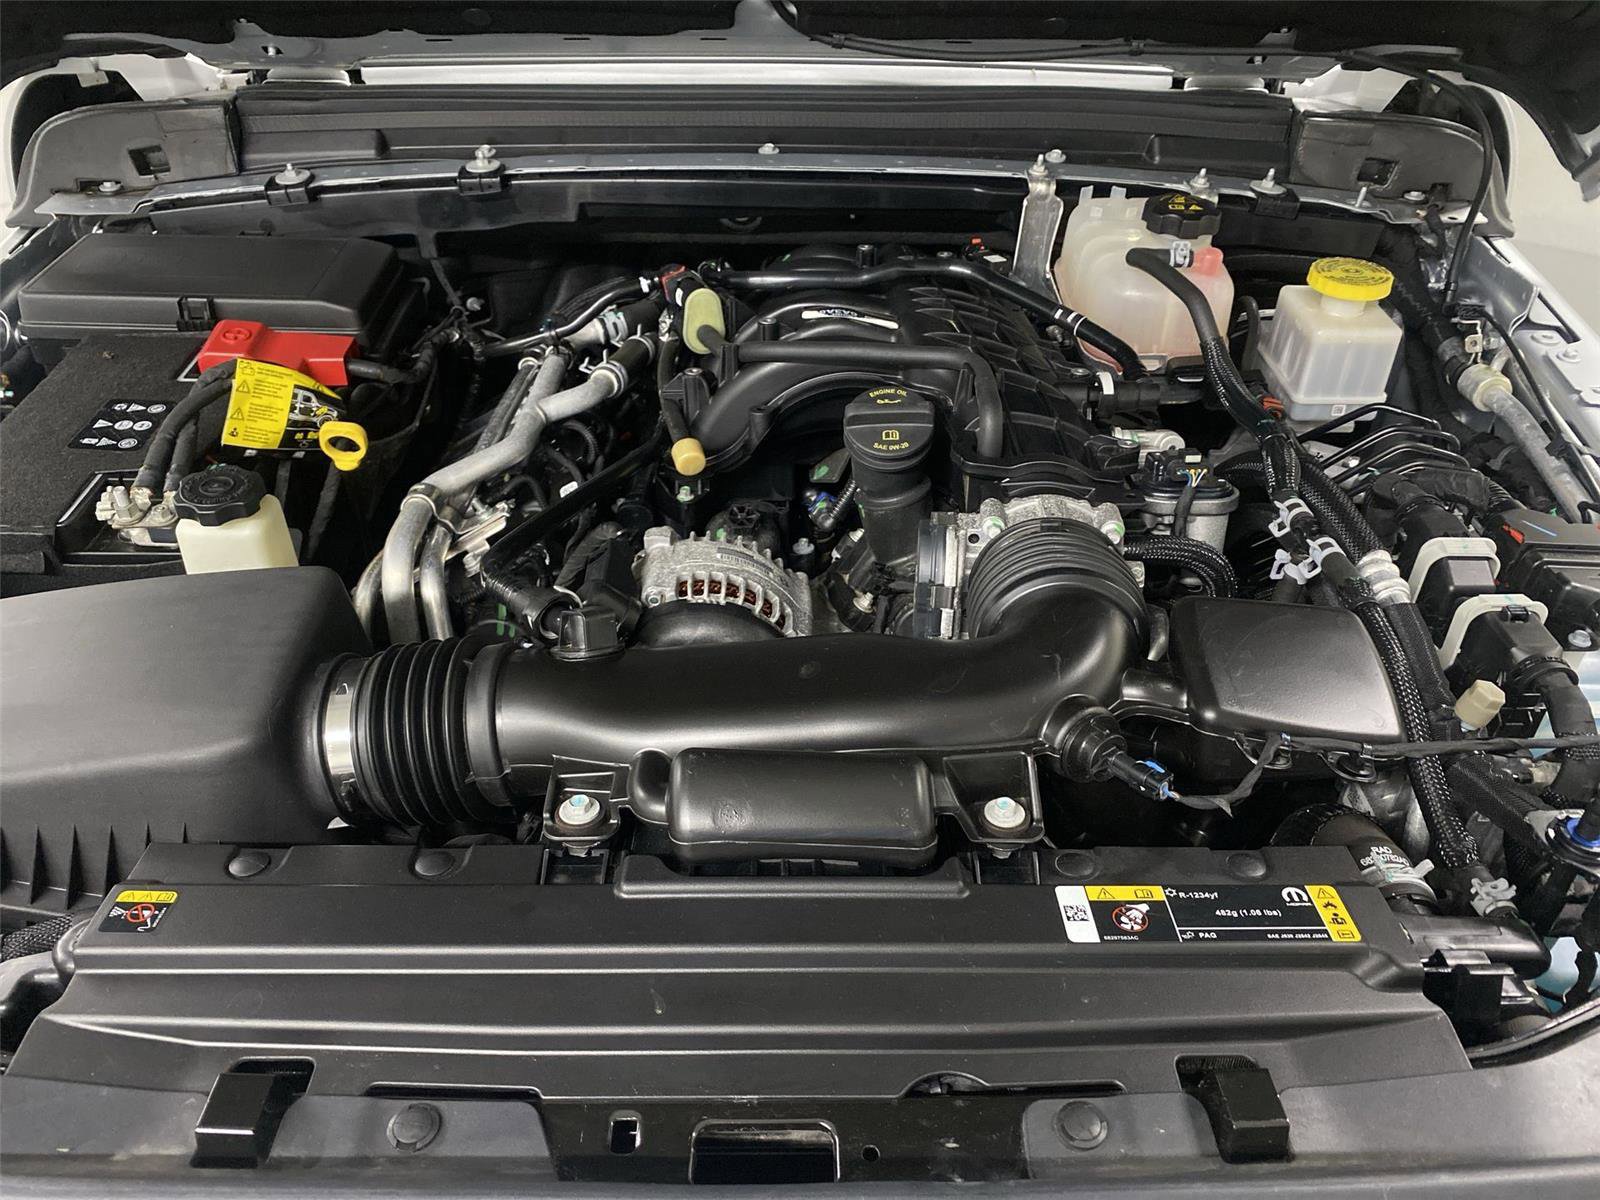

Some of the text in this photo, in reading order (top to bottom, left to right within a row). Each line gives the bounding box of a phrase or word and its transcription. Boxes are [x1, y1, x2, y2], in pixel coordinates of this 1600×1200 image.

[869, 389, 908, 398] ENGINE OIL
[873, 441, 910, 450] SAE 0W-20
[1371, 846, 1393, 855] RAD
[1178, 891, 1219, 900] R-1234yf
[1215, 909, 1239, 918] 482g
[1264, 908, 1282, 917] lbs)
